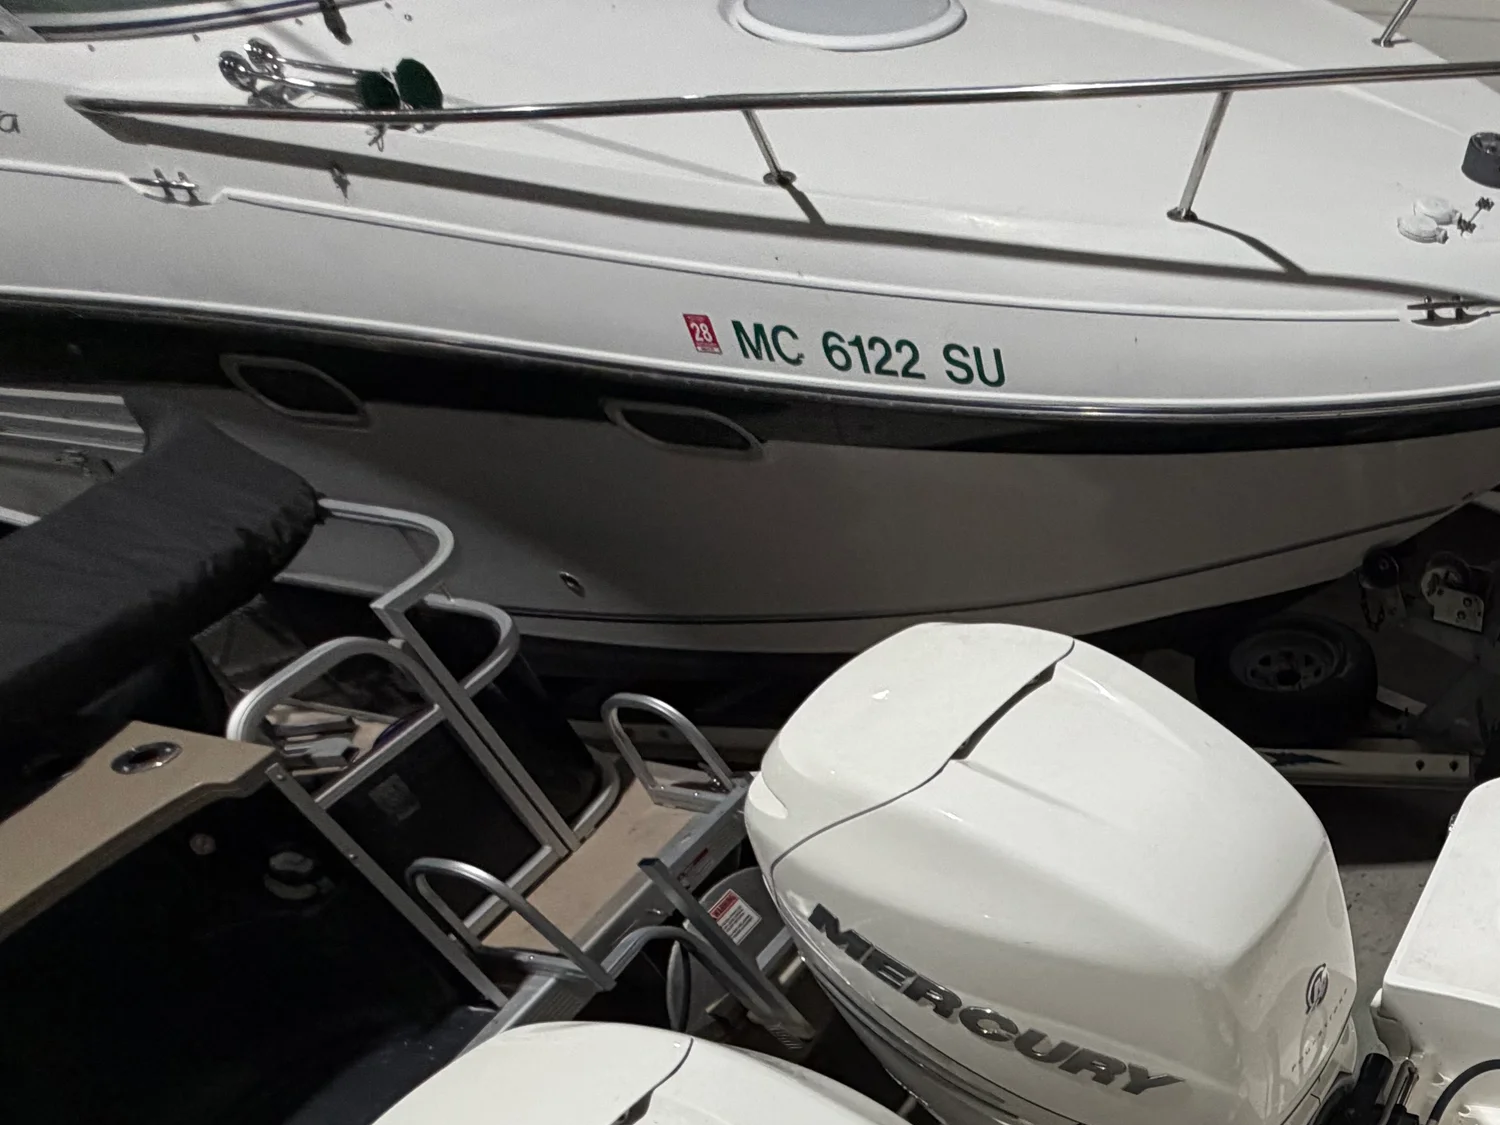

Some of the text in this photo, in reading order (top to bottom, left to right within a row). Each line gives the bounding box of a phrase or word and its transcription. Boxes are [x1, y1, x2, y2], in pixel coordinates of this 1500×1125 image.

[690, 322, 713, 342] 28
[731, 320, 1006, 388] MC 6122 SU
[807, 903, 1186, 1095] MERCURY
